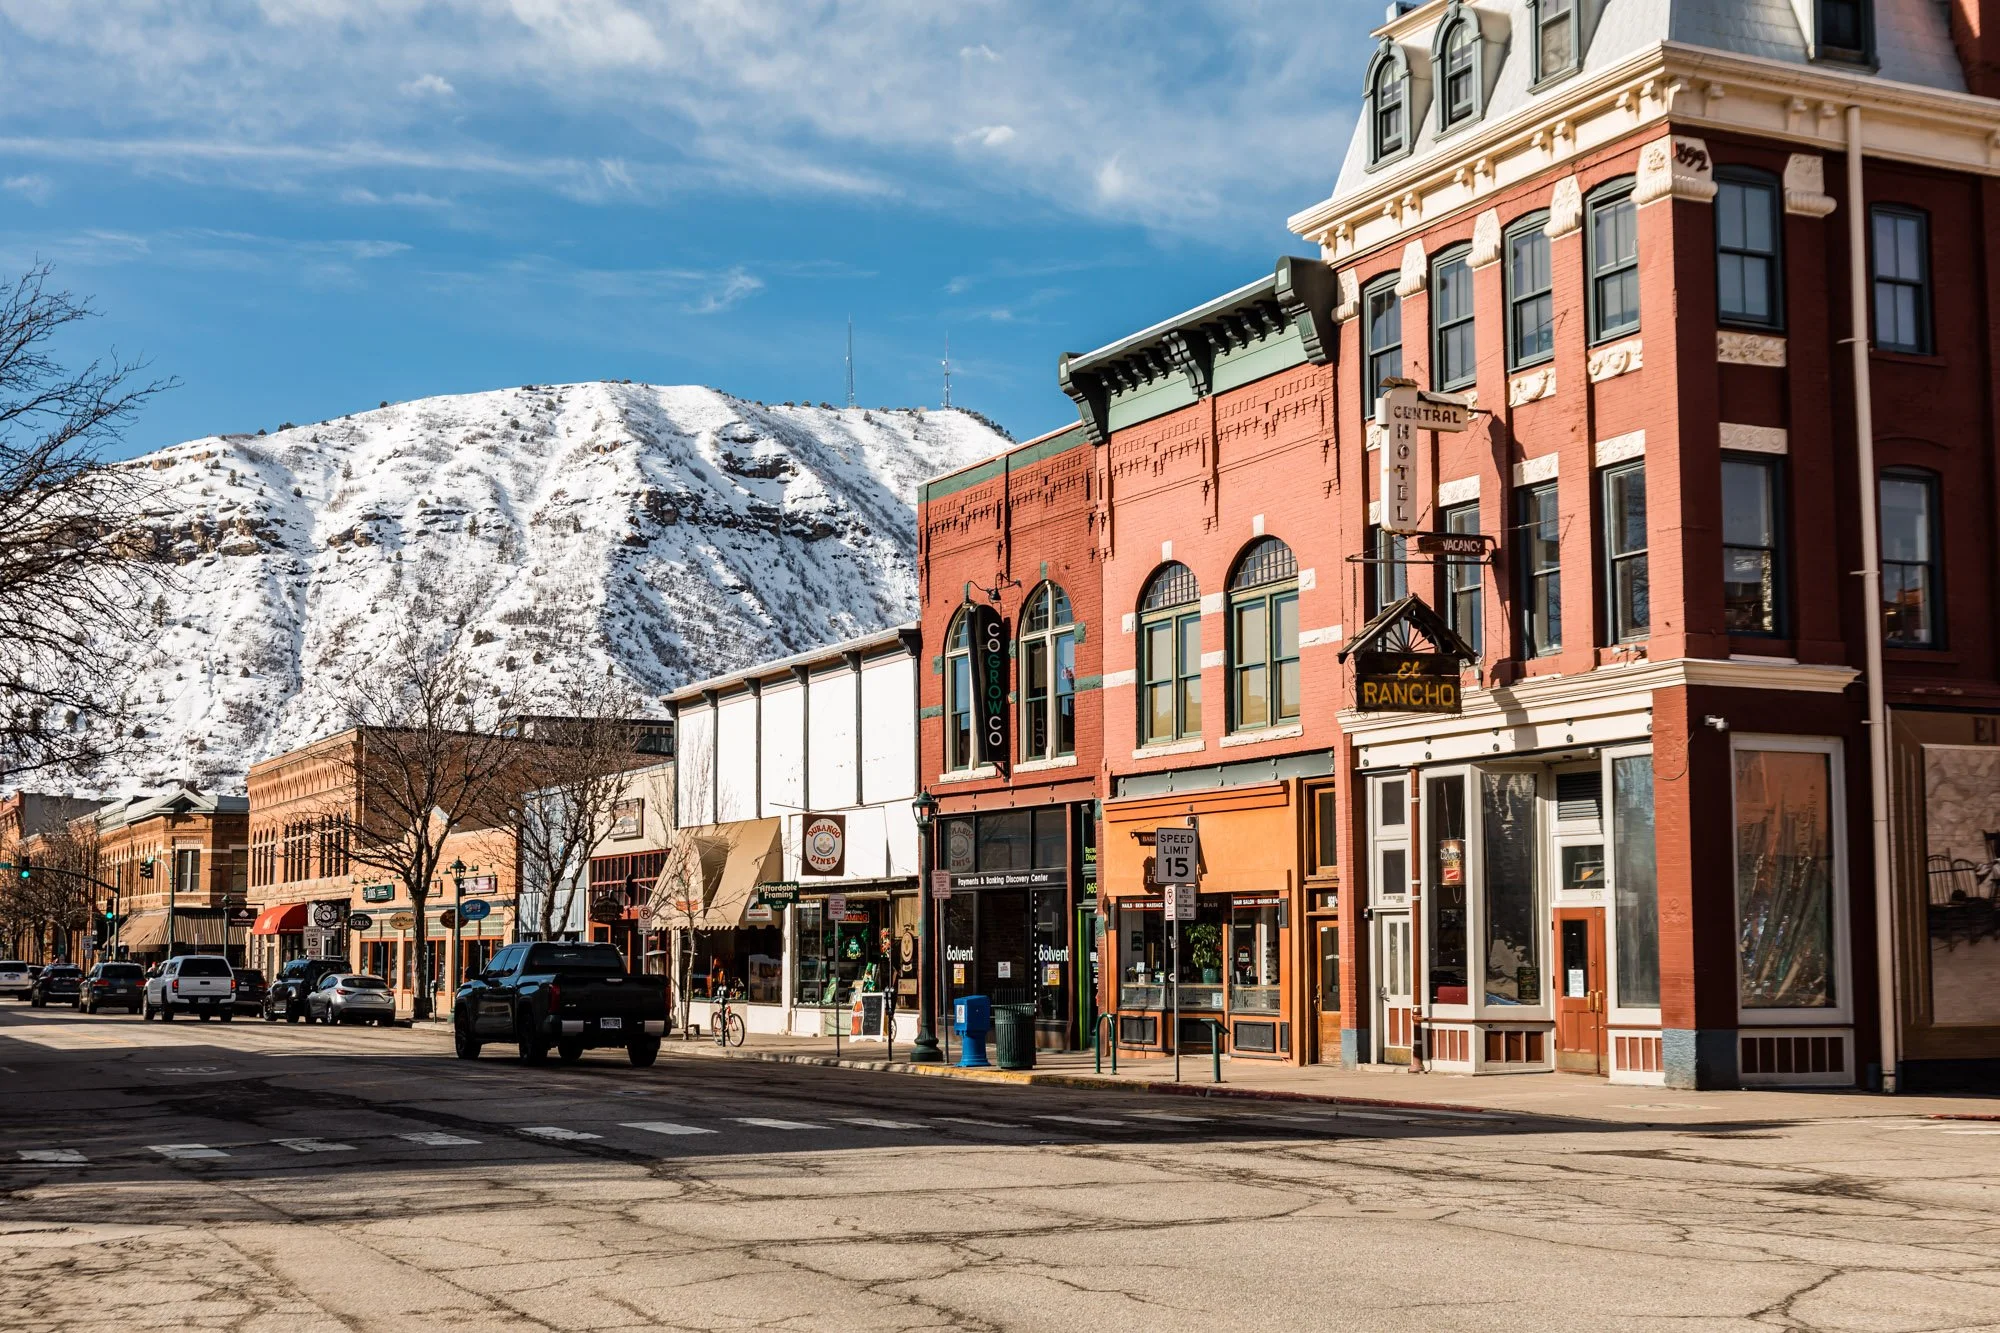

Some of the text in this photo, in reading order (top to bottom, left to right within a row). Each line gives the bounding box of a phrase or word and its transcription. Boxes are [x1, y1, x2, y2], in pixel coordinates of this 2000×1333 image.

[1393, 405, 1461, 424] CENTRAL
[1395, 423, 1410, 522] HOTEL
[1442, 539, 1481, 552] VACANCY
[1363, 681, 1455, 706] RANCHO
[808, 824, 841, 838] DURANGO
[1160, 834, 1193, 843] SPEED
[1163, 846, 1189, 854] LIMIT
[811, 855, 836, 864] DINER
[1165, 857, 1189, 877] 15
[957, 877, 979, 887] Payments
[986, 875, 1004, 885] Banking
[1005, 874, 1029, 884] Discovery
[1030, 873, 1048, 882] Center
[760, 884, 797, 892] Affordable
[764, 891, 793, 899] Framing
[307, 938, 318, 946] 15
